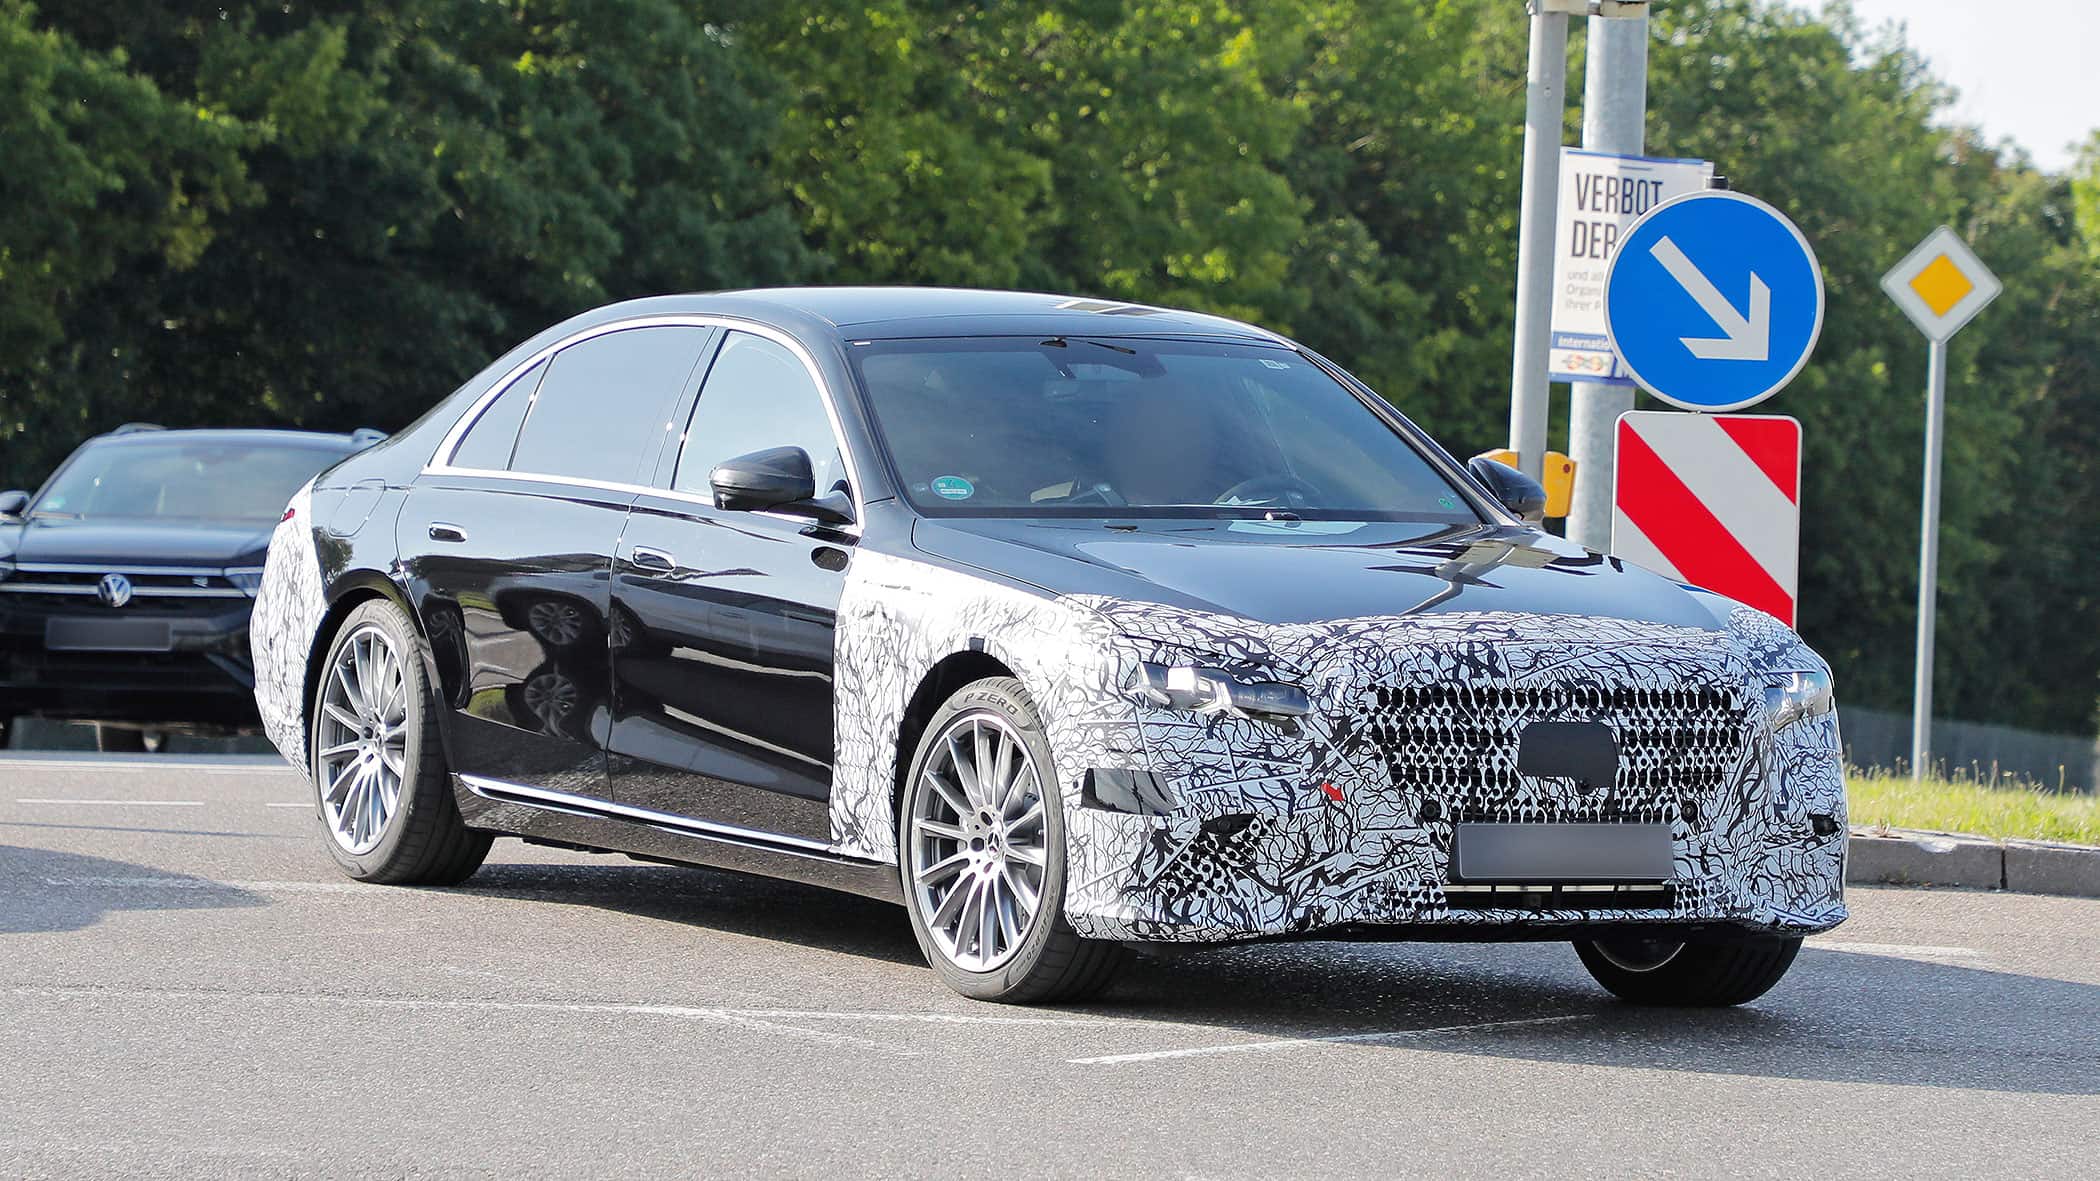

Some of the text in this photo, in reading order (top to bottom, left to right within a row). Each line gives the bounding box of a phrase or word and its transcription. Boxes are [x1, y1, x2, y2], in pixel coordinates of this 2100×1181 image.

[1576, 173, 1663, 215] VERBOT
[1571, 221, 1617, 259] DER
[964, 692, 1019, 715] P ZERO
